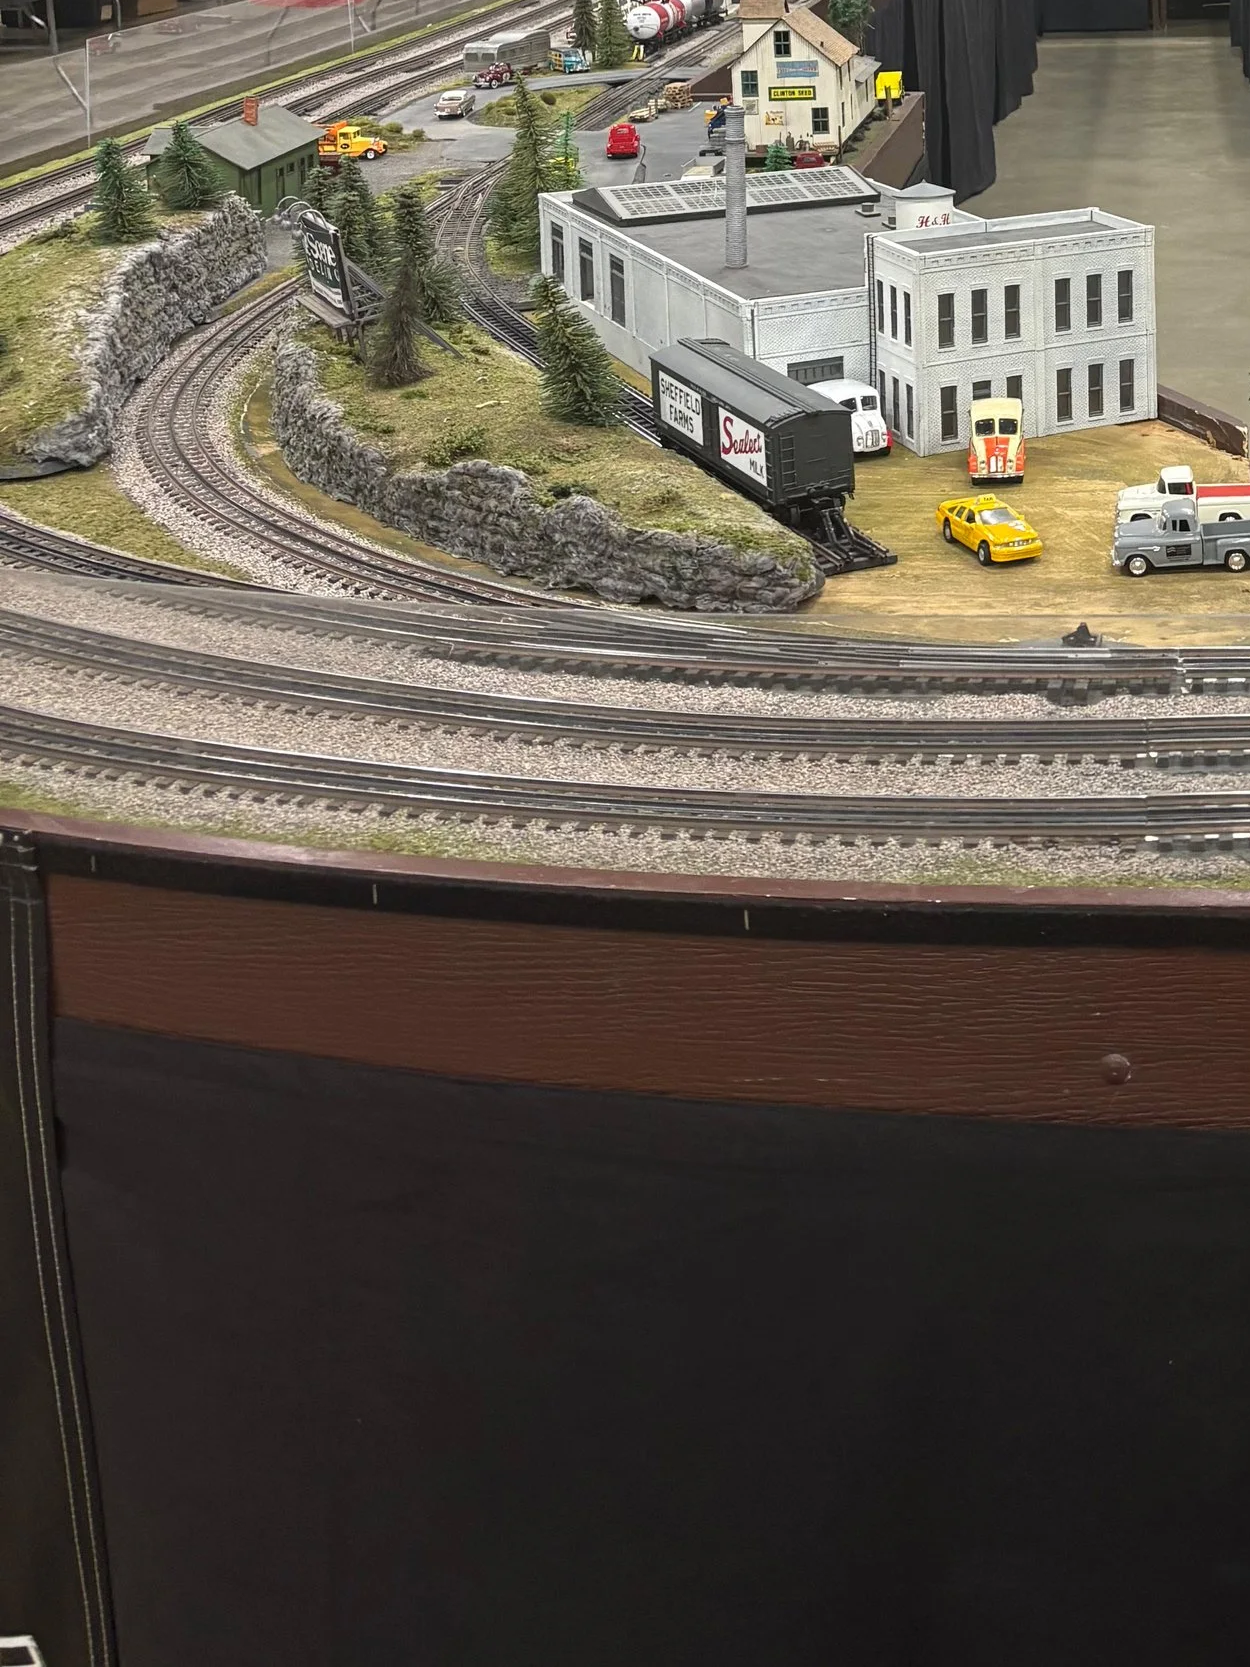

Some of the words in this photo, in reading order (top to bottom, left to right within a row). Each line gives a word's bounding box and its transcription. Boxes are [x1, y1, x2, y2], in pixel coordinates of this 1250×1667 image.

[660, 377, 700, 416] SHEFFIELD
[669, 403, 694, 433] FARMS
[749, 458, 765, 478] MILK
